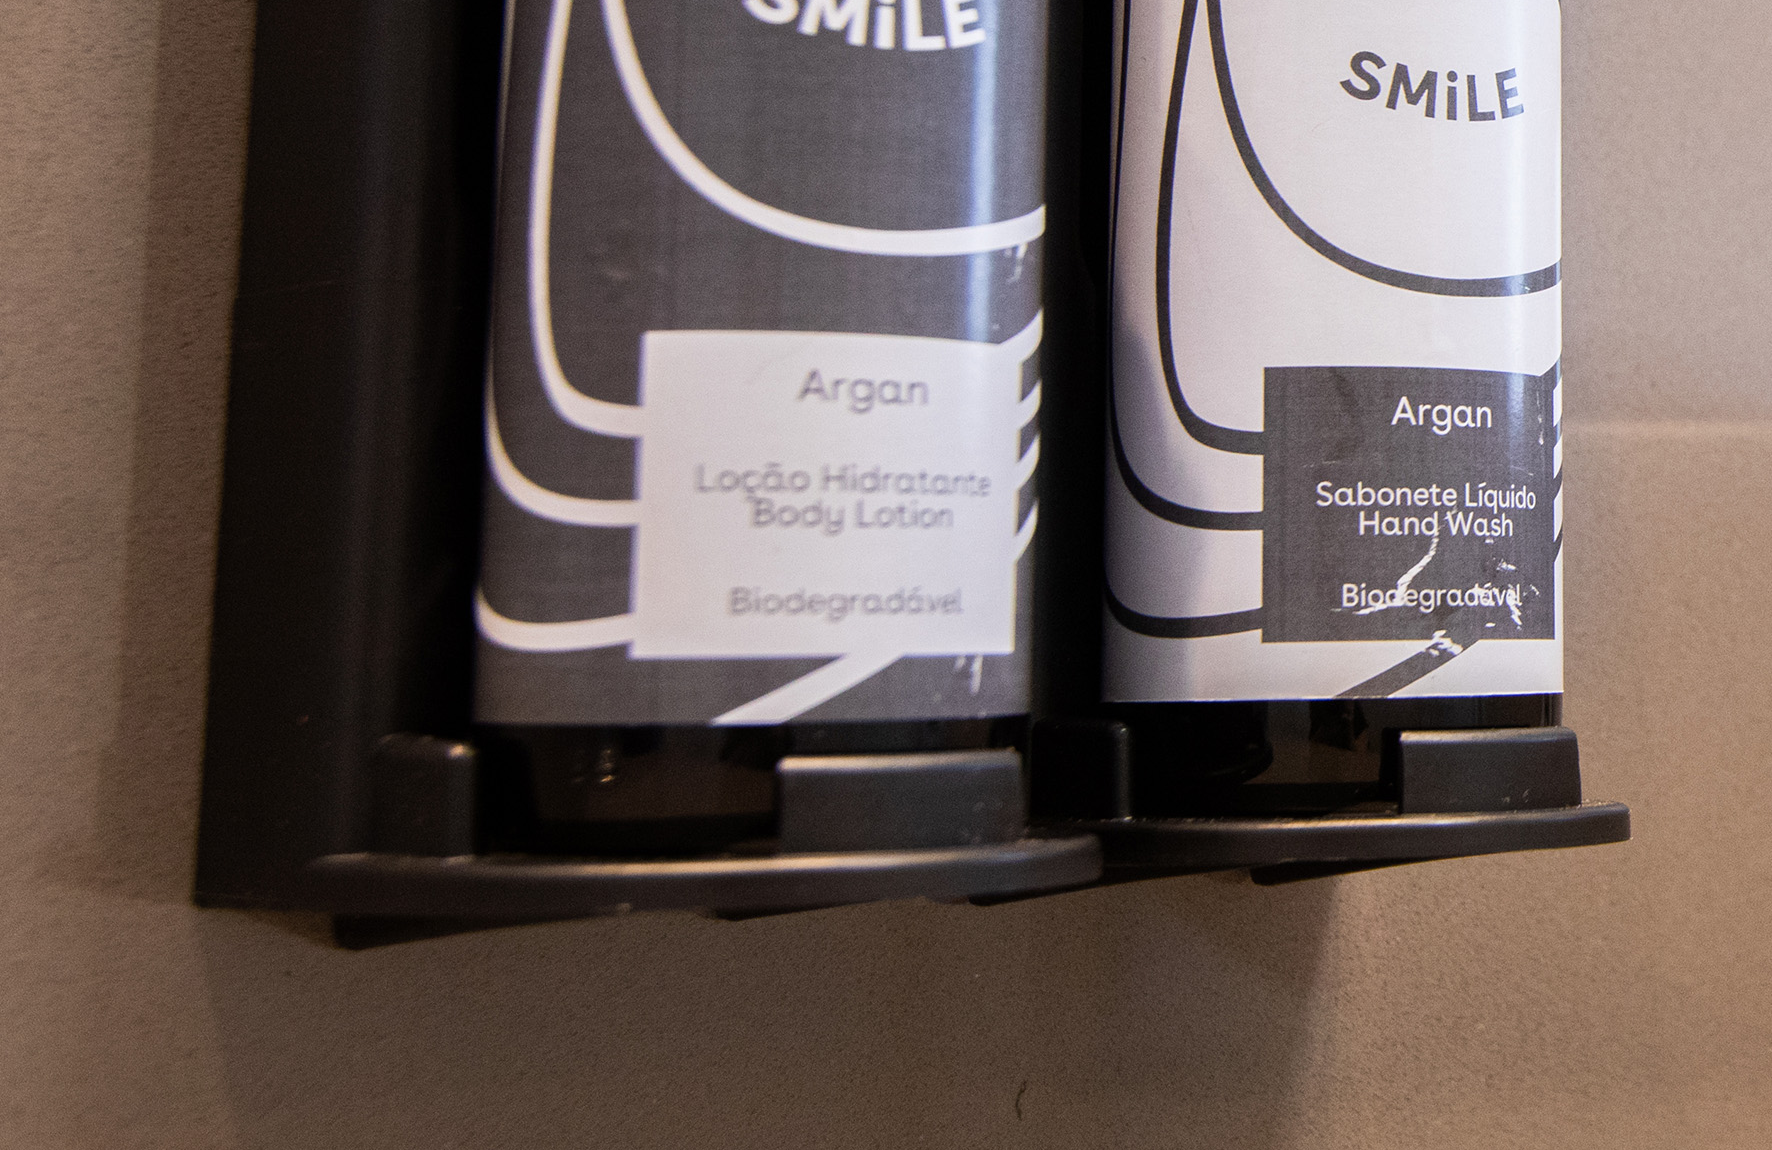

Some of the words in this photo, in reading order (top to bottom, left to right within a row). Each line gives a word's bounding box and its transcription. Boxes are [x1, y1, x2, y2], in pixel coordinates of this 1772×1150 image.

[798, 369, 929, 413] Argan
[1391, 396, 1492, 435] Argan
[694, 462, 809, 502] Loção
[822, 464, 992, 498] Hidratante
[1316, 481, 1458, 507] Sabonete
[1464, 482, 1536, 514] Líquido
[752, 498, 845, 535] Body
[856, 499, 954, 529] Lotion
[1358, 511, 1438, 536] Hand
[1447, 511, 1513, 537] Wash
[729, 585, 963, 622] Biodegradável
